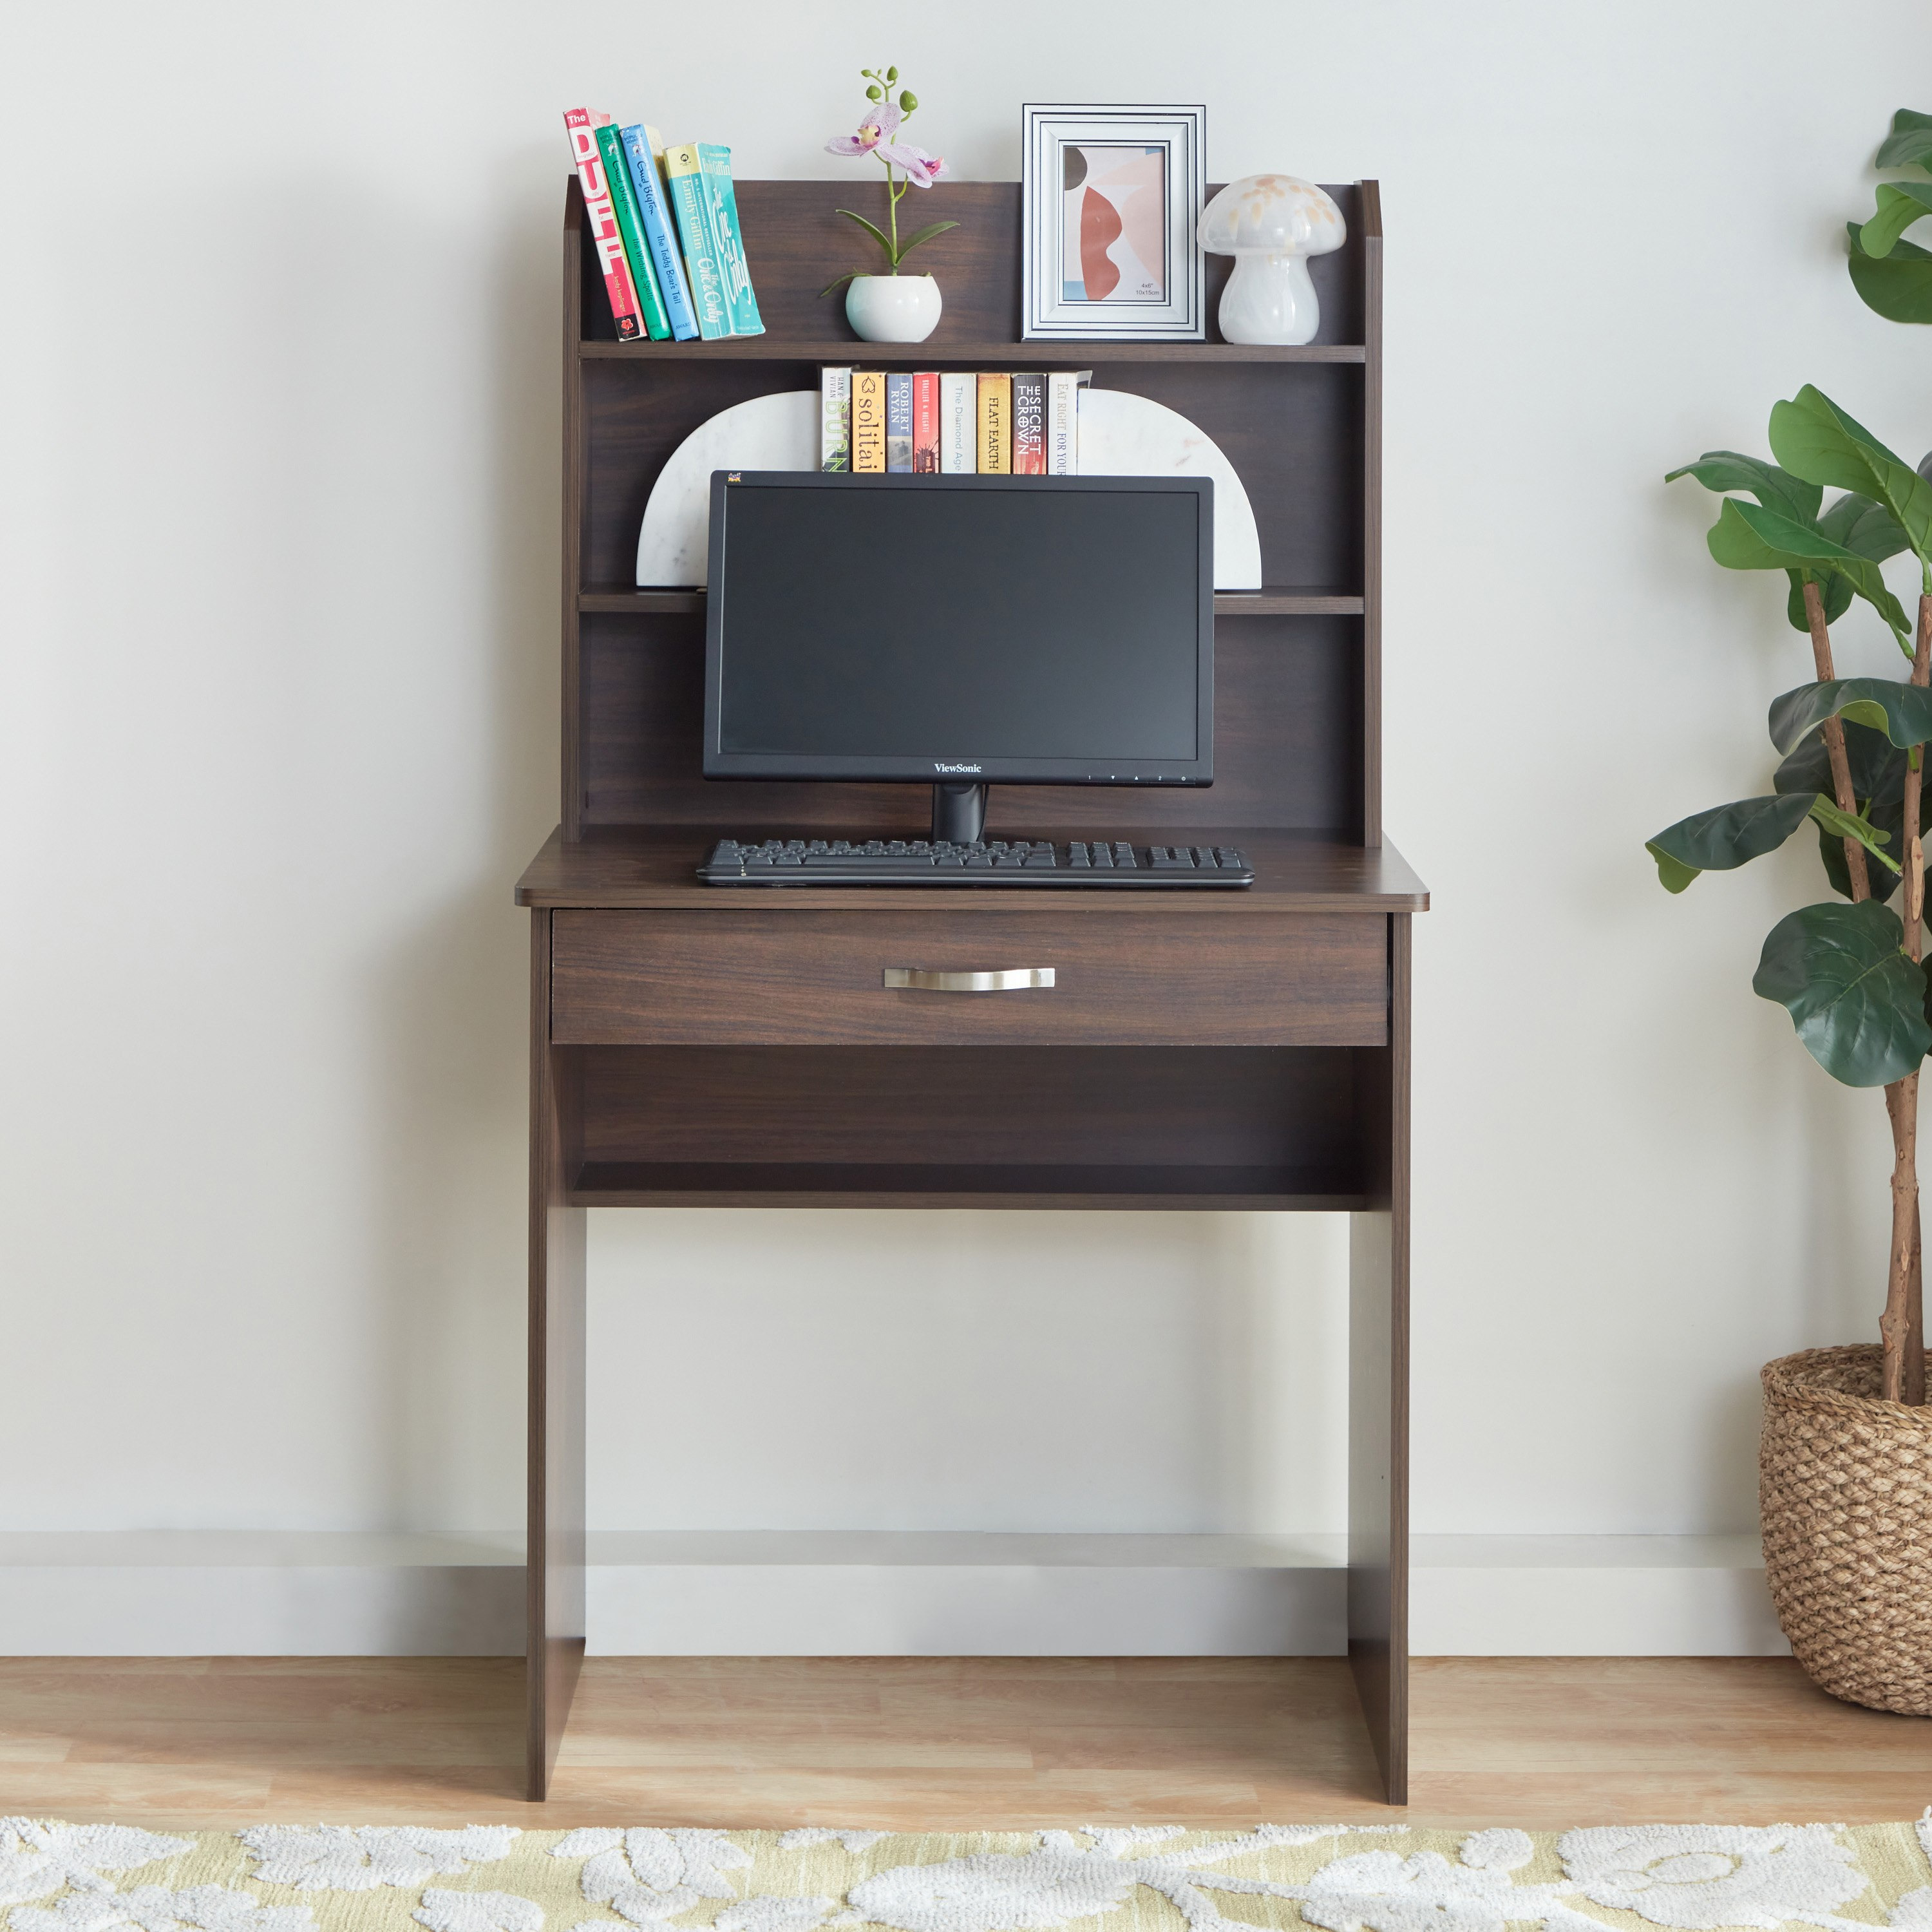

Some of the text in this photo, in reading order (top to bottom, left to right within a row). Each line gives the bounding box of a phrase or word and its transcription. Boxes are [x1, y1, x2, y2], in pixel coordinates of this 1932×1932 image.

[567, 114, 586, 124] The
[569, 126, 622, 276] DUFF
[618, 185, 630, 216] Blyton
[637, 160, 657, 216] Enid Blyton
[682, 180, 697, 214] Emily
[689, 215, 704, 251] Giffin
[697, 191, 706, 227] INTERNATIONAL
[704, 227, 714, 257] BESTSELLER
[636, 250, 646, 280] Wishing
[642, 279, 654, 301] Spells
[657, 234, 681, 305] The Teddy Bear's Tail
[697, 258, 715, 284] One
[703, 290, 724, 323] Only
[891, 390, 900, 423] RYAN
[900, 382, 909, 432] ROBERT
[1017, 385, 1041, 395] THE
[825, 401, 848, 472] BURN
[989, 397, 999, 470] FLAT EARTH
[1018, 395, 1029, 455] CROWN
[1029, 396, 1041, 455] SECRET
[1057, 383, 1068, 476] EAT RIGHT FOR YOUR
[953, 453, 963, 471] Age
[934, 763, 981, 773] ViewSonic
